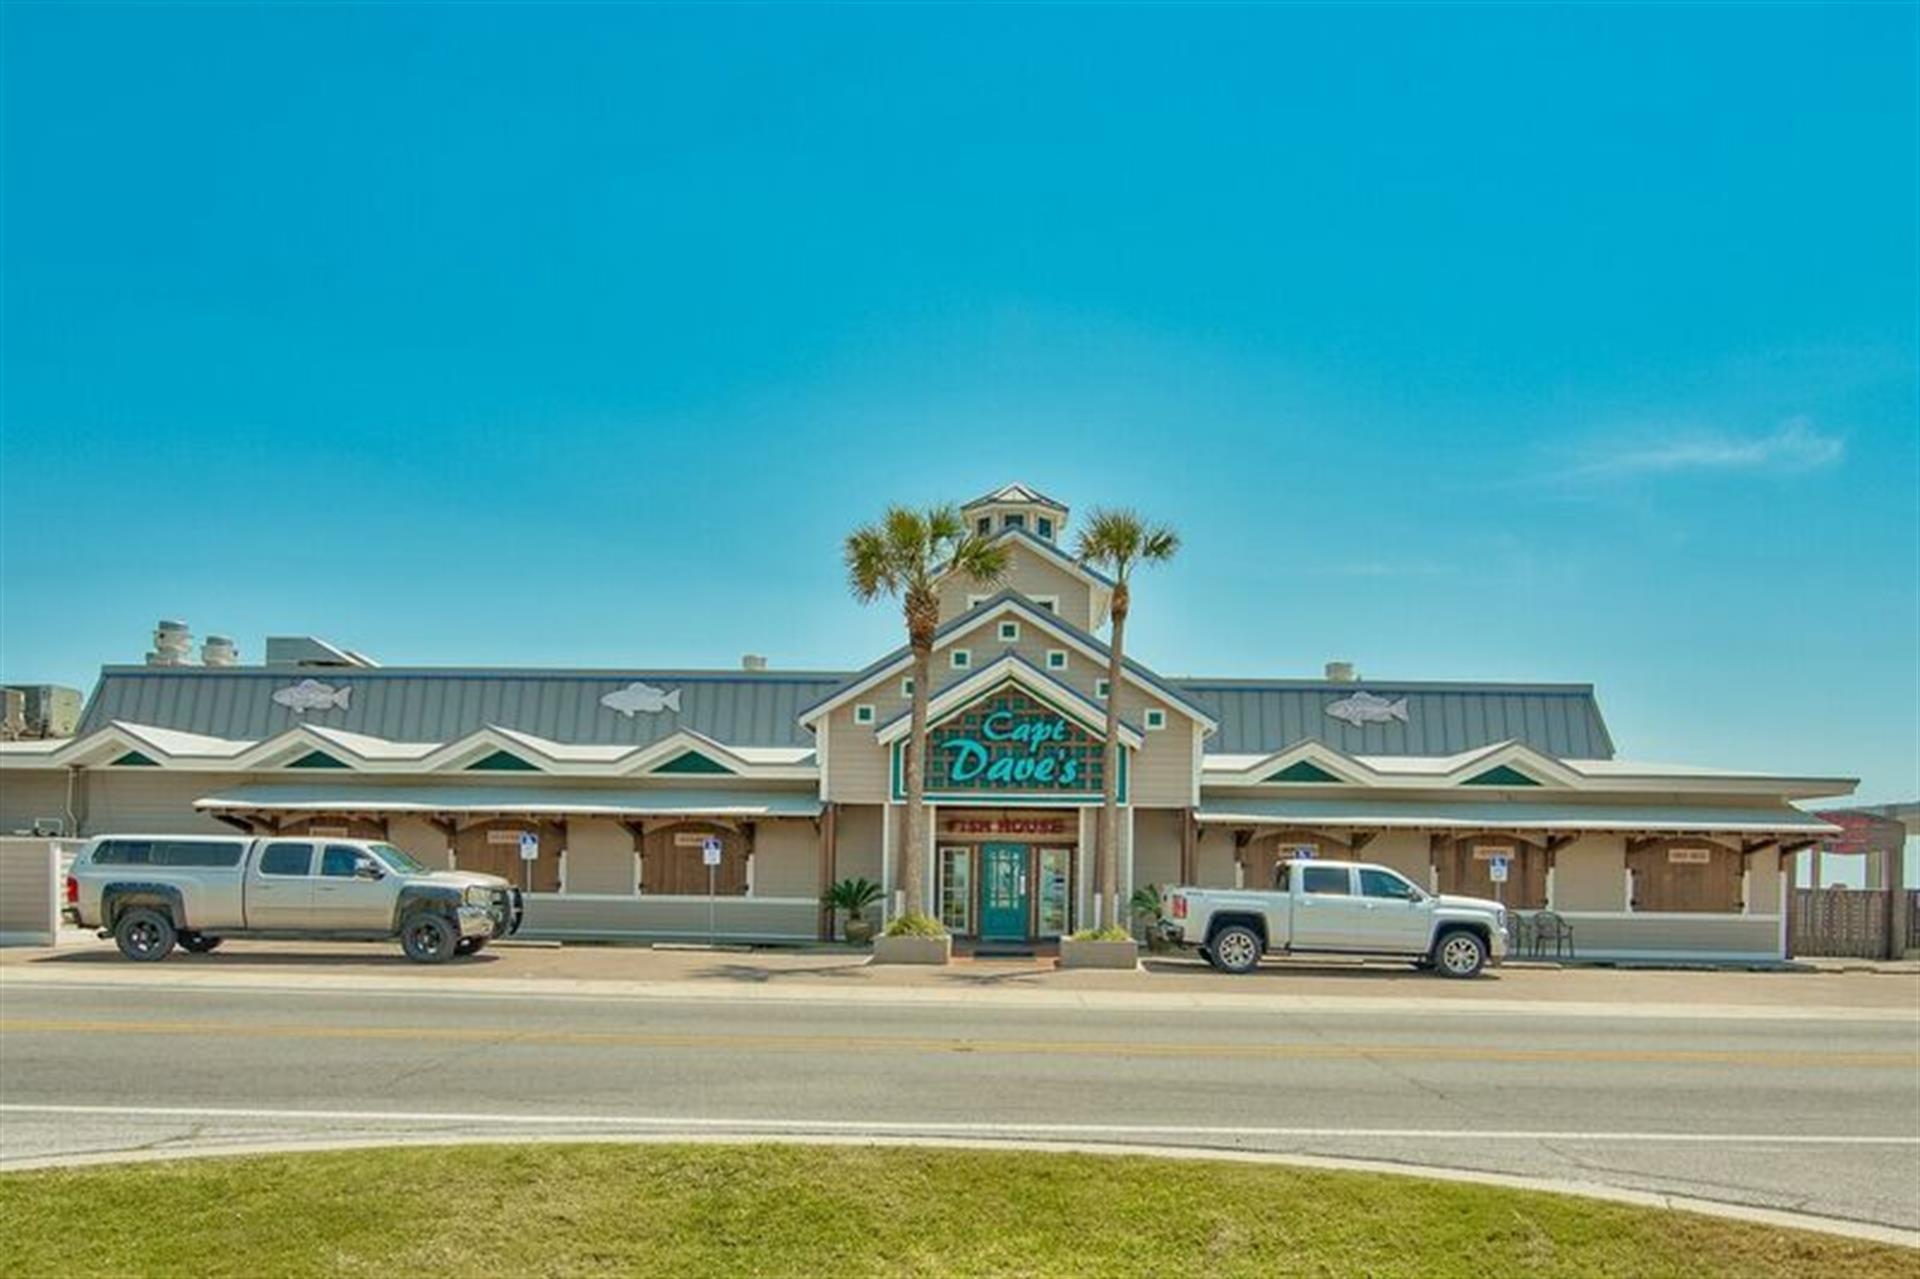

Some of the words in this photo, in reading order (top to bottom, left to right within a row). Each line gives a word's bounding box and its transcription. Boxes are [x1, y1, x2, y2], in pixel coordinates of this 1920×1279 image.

[983, 711, 1065, 752] Capt
[941, 739, 1078, 783] Dave's
[947, 819, 992, 833] FISH
[997, 819, 1064, 833] HOUSE
